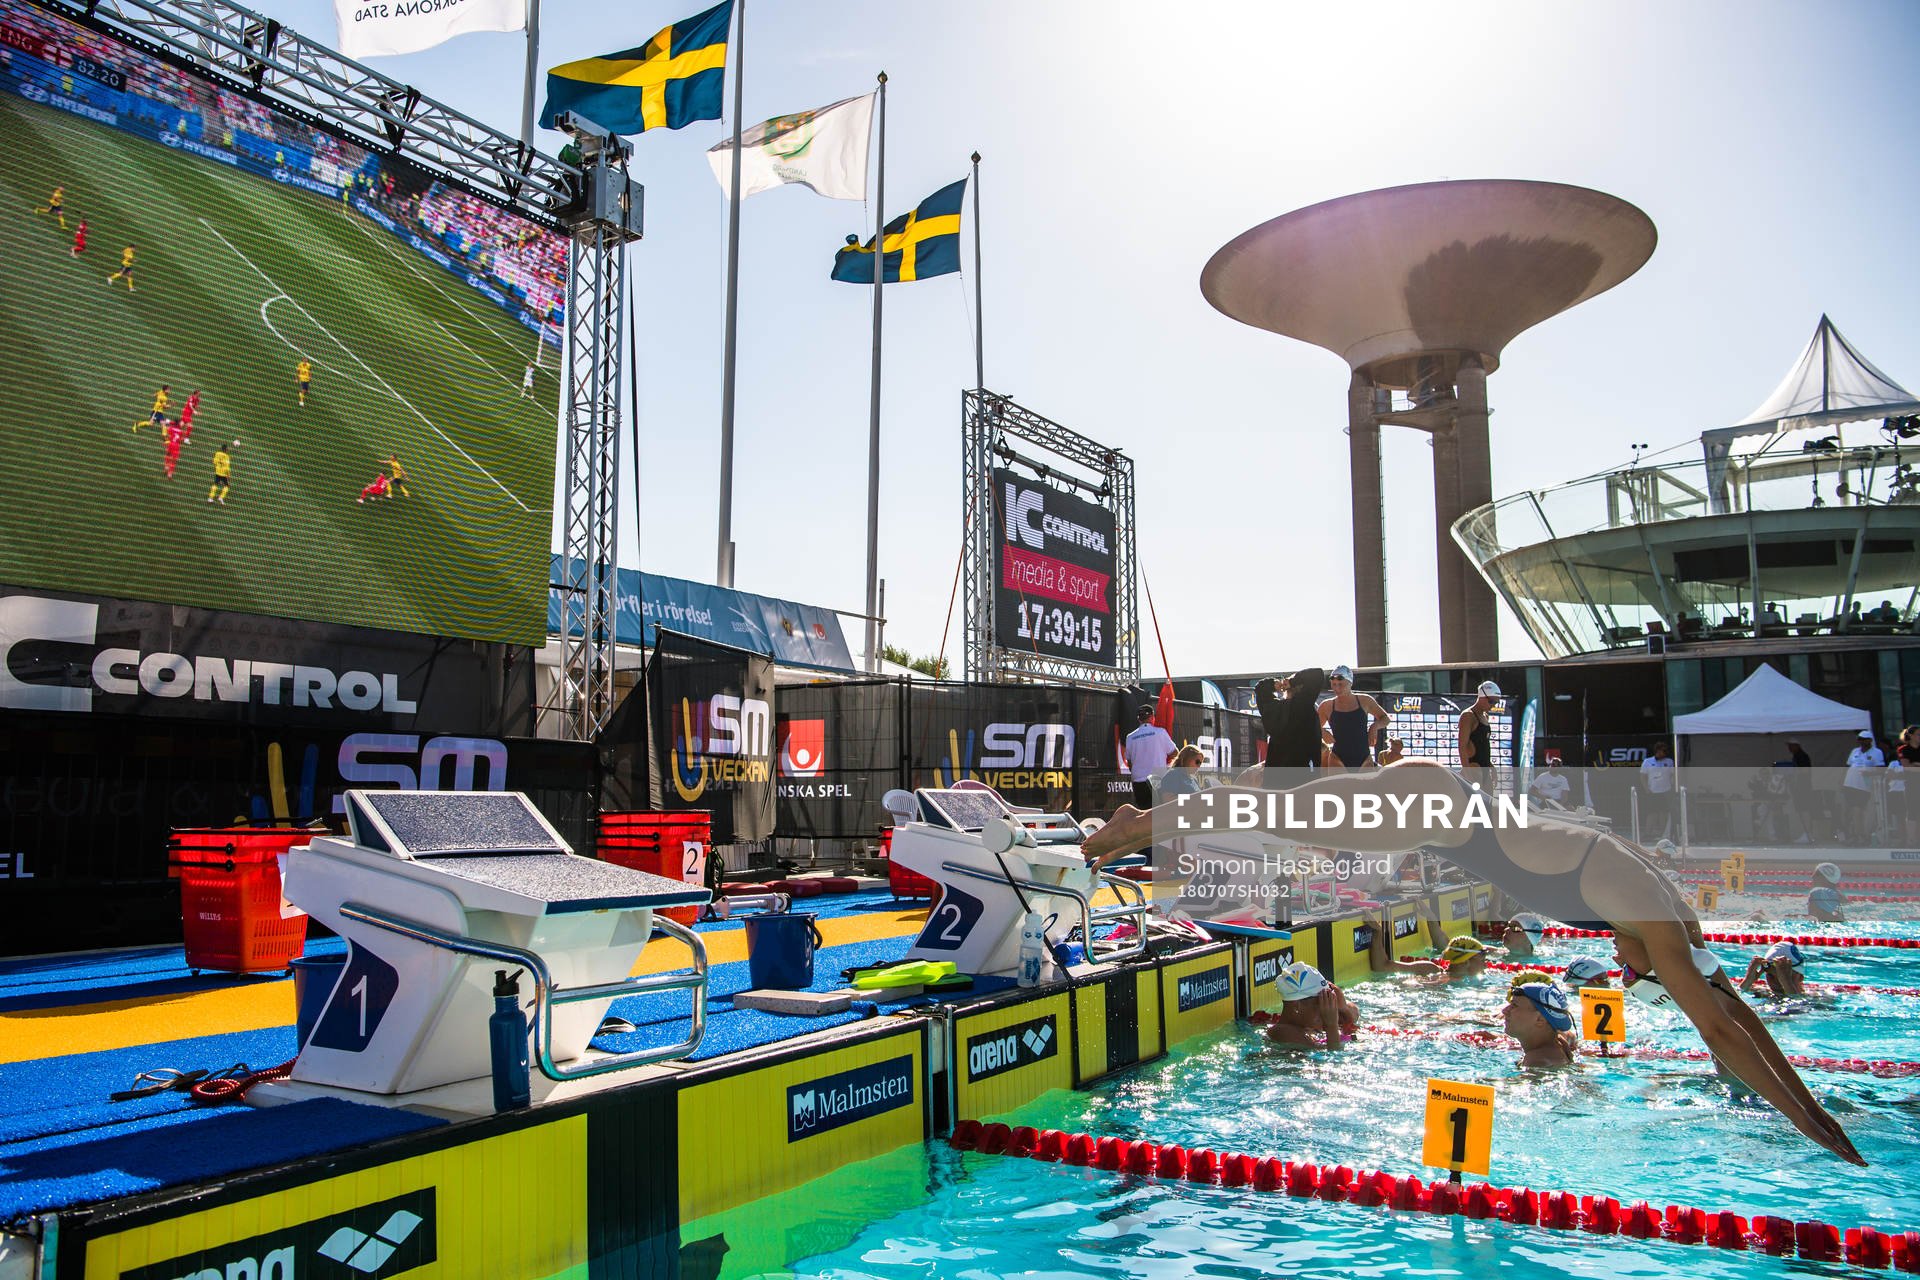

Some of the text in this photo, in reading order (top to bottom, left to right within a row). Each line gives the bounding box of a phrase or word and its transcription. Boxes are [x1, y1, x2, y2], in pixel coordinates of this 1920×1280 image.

[1005, 482, 1109, 555] IC CONTROL
[1011, 558, 1100, 602] media & sport
[1017, 600, 1102, 652] 17:39:15
[92, 647, 417, 714] CONTROL
[713, 759, 768, 783] VECKAN
[985, 771, 1072, 788] VECKAN
[1107, 781, 1134, 793] SVENSKA
[818, 784, 852, 797] SPEL
[686, 848, 698, 875] 2
[940, 904, 961, 941] 2
[1254, 957, 1277, 982] arena
[352, 975, 367, 1036] 1
[1190, 976, 1229, 1001] Malmsten
[1594, 1003, 1613, 1035] 2
[970, 1035, 1018, 1075] arena
[818, 1074, 909, 1119] Malmsten
[1442, 1092, 1489, 1106] Malmsten
[1450, 1107, 1468, 1163] 1
